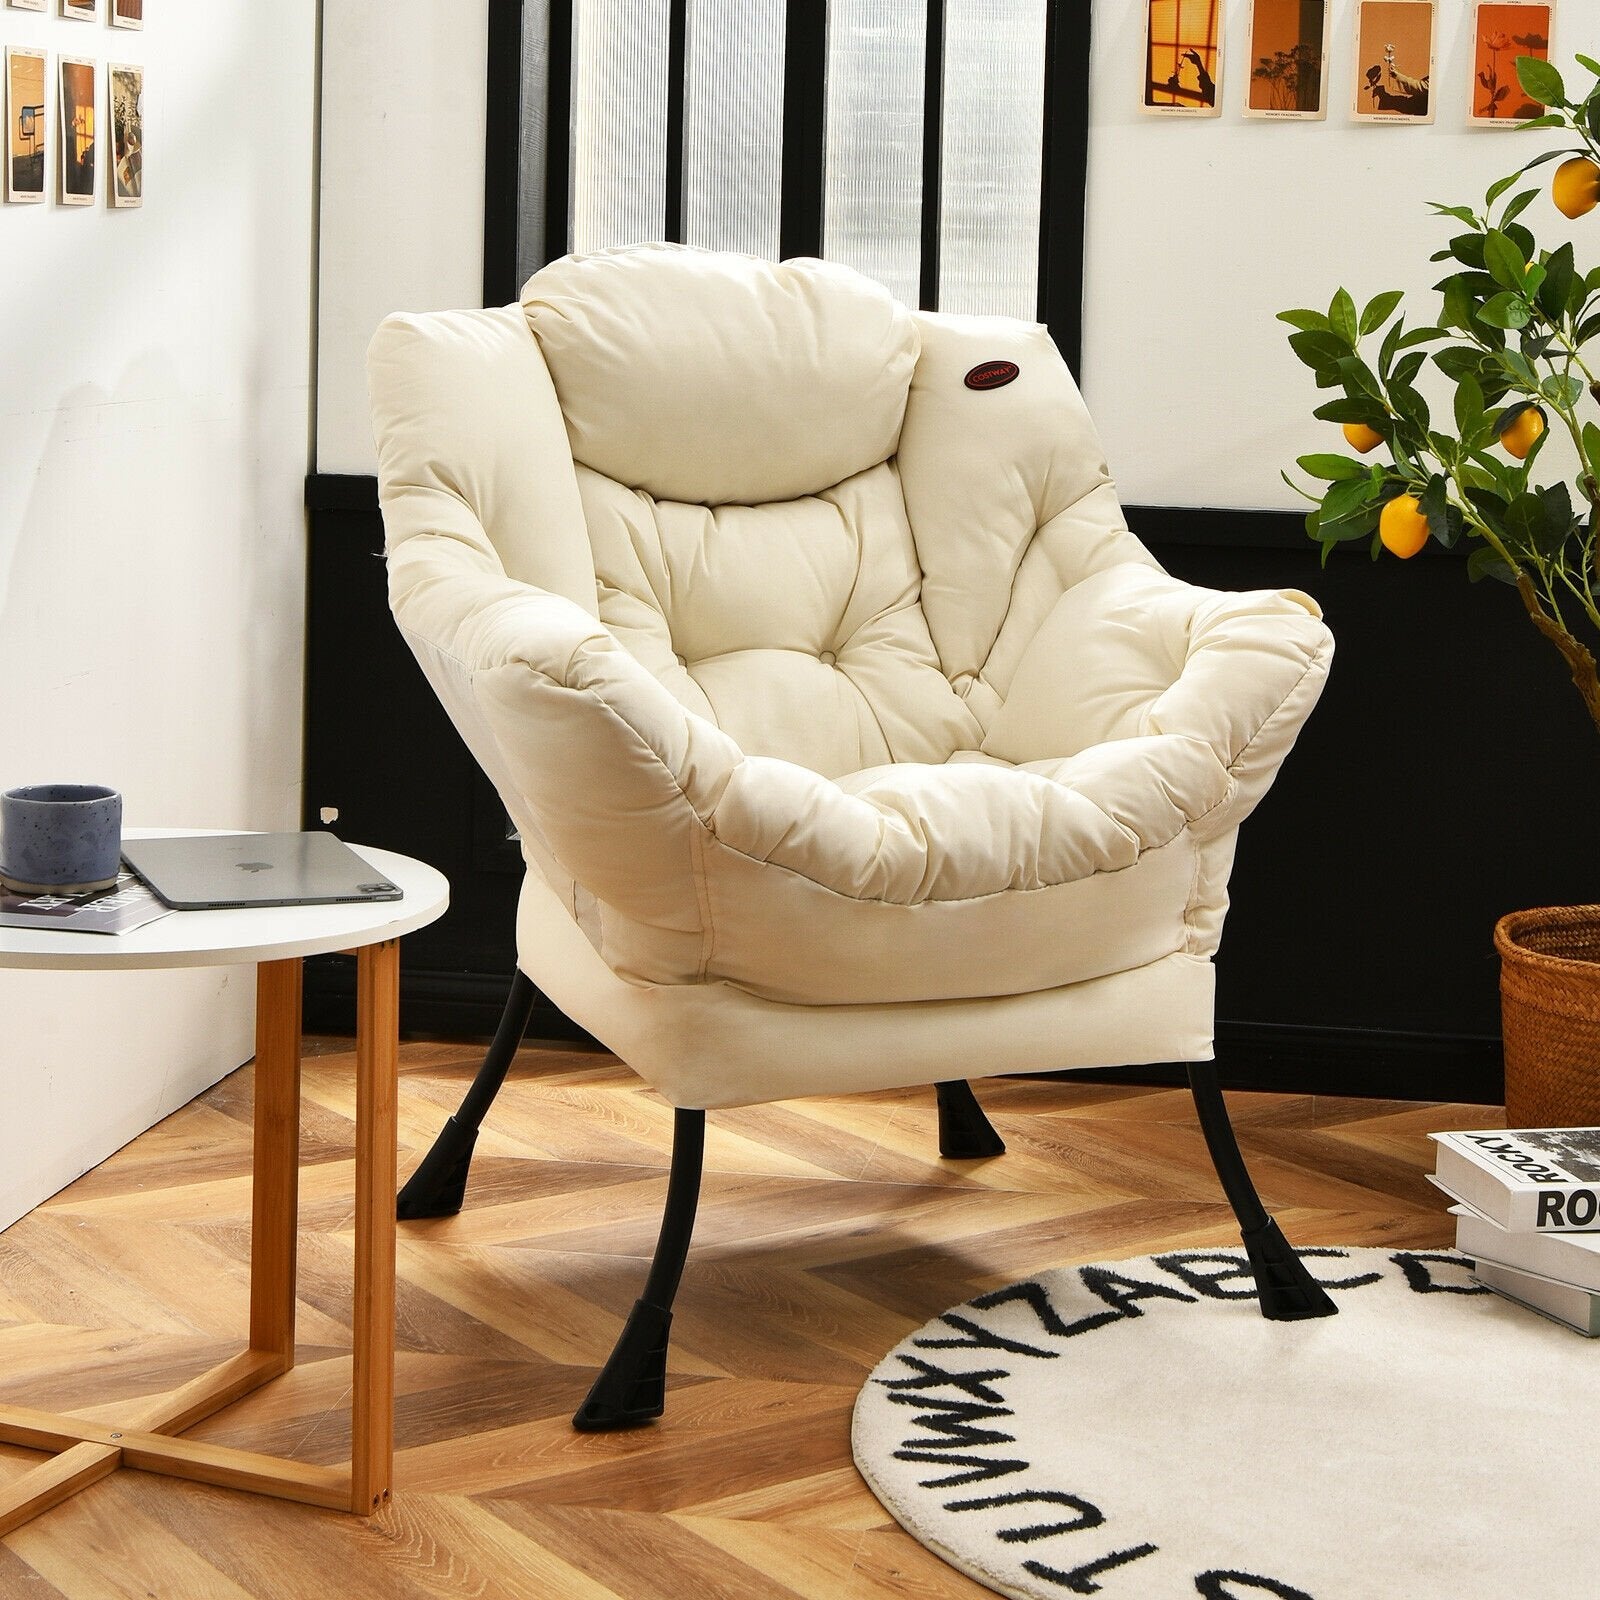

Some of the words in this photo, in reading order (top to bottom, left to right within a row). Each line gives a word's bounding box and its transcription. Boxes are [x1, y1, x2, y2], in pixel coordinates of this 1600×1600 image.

[972, 365, 1012, 382] COSTWAY
[1465, 1134, 1569, 1183] ROCKY
[1536, 1189, 1600, 1227] RO
